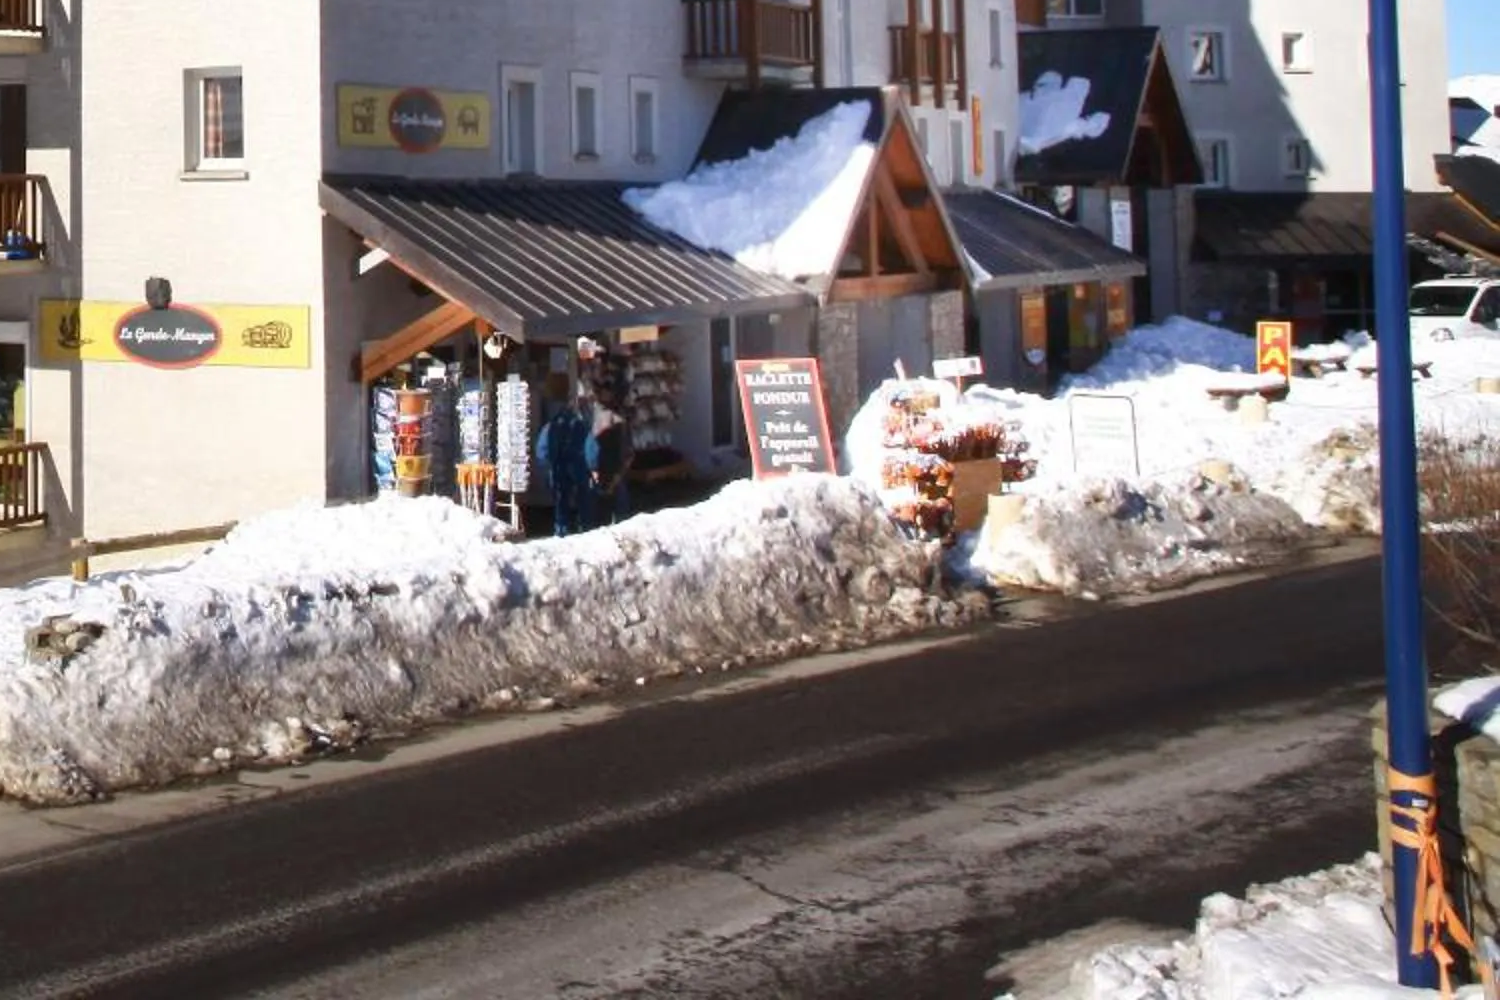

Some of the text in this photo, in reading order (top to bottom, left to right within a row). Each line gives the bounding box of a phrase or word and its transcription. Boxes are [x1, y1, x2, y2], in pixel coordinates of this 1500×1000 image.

[1263, 327, 1285, 371] PA
[745, 373, 813, 386] RACLETTE
[753, 391, 811, 405] FONDUE
[793, 421, 809, 433] de
